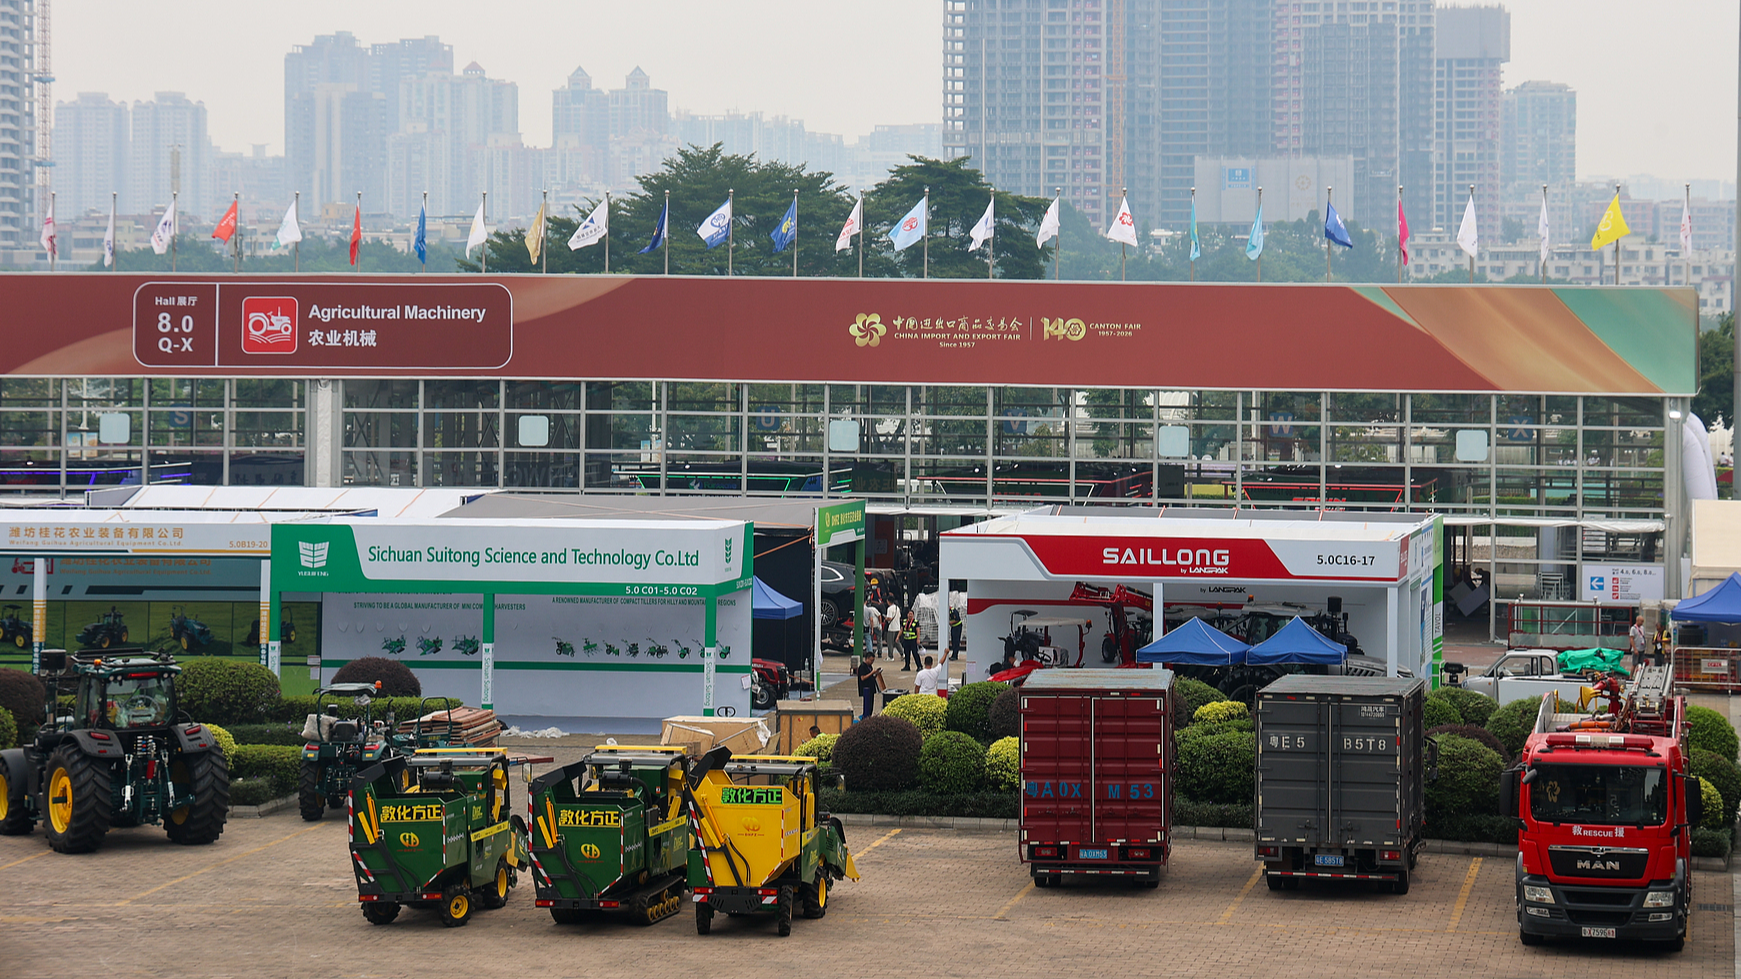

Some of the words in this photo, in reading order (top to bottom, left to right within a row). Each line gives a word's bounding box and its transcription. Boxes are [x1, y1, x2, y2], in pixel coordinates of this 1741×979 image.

[155, 296, 176, 306] Hall
[177, 295, 197, 306] 展厅
[308, 304, 400, 323] Agricultural
[404, 305, 486, 322] Machinery
[156, 312, 194, 333] 8.0
[308, 330, 377, 348] 农业机械
[894, 332, 919, 340] CHINA
[157, 337, 194, 352] Q-X
[9, 526, 184, 539] 潍坊桂花农业装备有限公司
[229, 540, 268, 548] 5.0B19-20
[368, 545, 422, 562] Sichuan
[426, 546, 480, 567] Suitong
[484, 547, 537, 564] Science
[541, 548, 567, 565] and
[571, 548, 651, 570] Technology
[655, 549, 699, 567] Co.Ltd
[1102, 547, 1230, 566] SAILLONG
[1315, 553, 1376, 566] 5.0C16-17
[625, 586, 640, 595] 5.0
[641, 586, 678, 595] C01-5.0
[679, 587, 698, 596] C02
[353, 601, 376, 609] STRIVING
[414, 602, 454, 610] MANUFACTURER
[453, 602, 460, 610] OF
[717, 598, 736, 606] REGIONS
[1582, 830, 1614, 838] RESCUE
[1576, 859, 1620, 870] MAN
